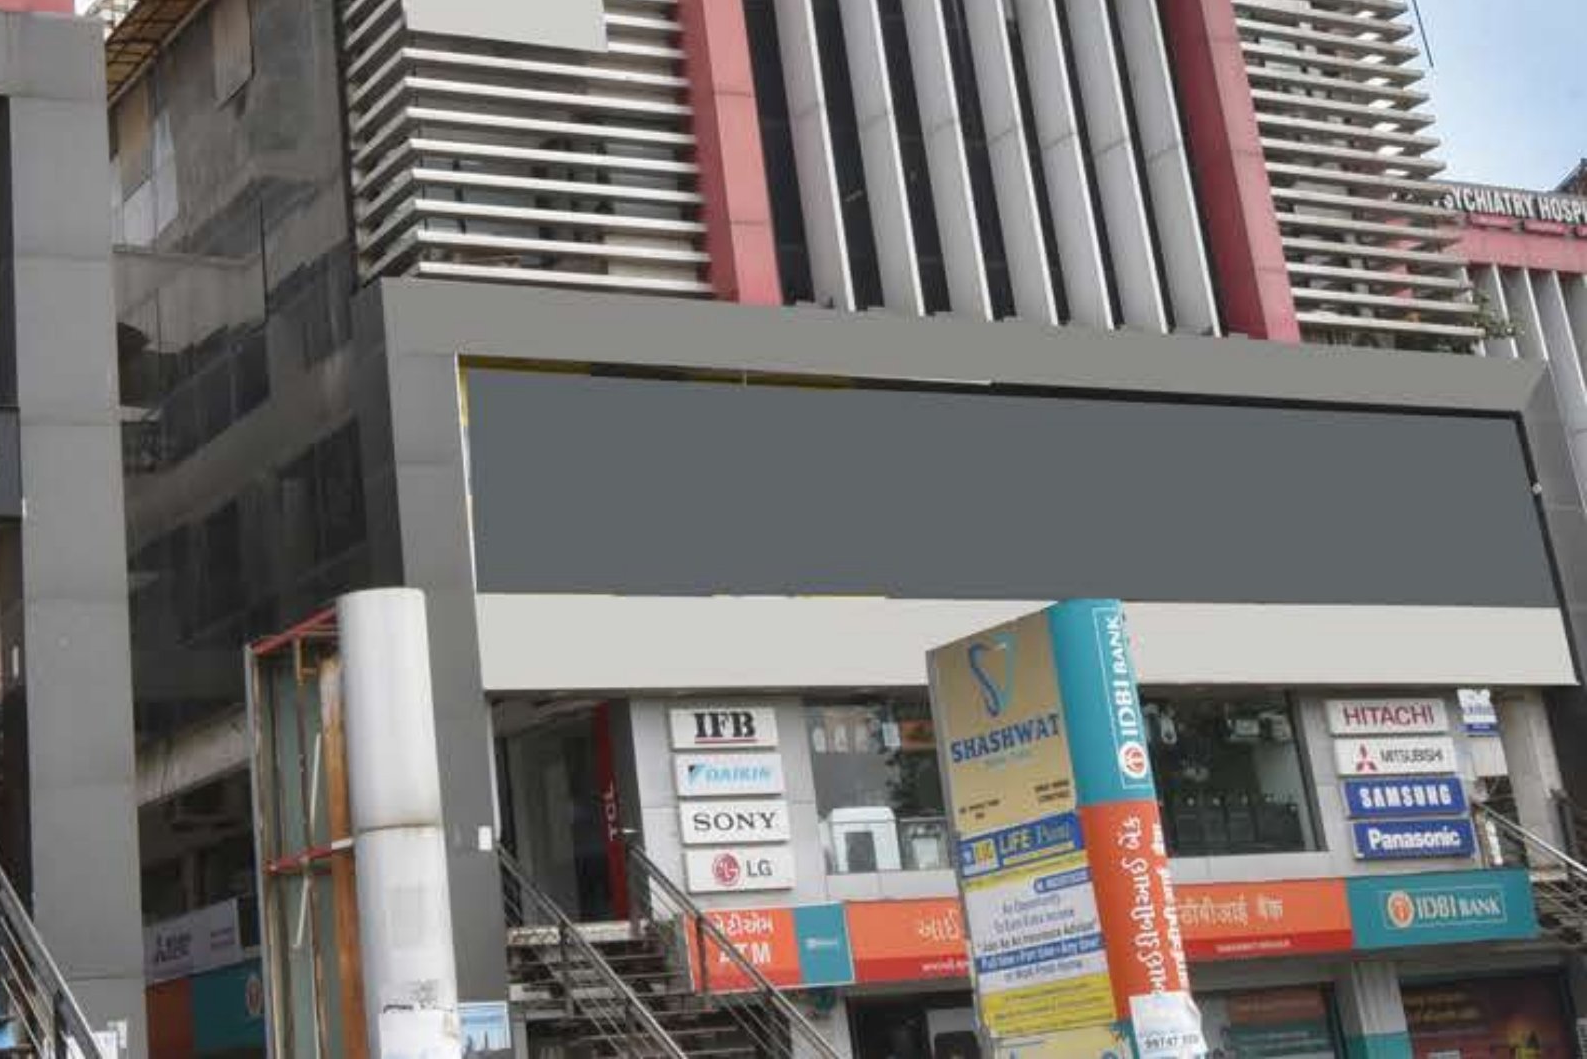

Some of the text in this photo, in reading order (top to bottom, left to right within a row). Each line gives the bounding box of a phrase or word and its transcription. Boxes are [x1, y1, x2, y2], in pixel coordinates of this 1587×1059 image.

[1432, 187, 1534, 217] YCHIATRY
[1105, 614, 1141, 737] IDBI BANK
[694, 711, 756, 738] IFB
[1343, 703, 1435, 727] HITACHI
[951, 712, 1059, 763] SHASHWAT
[1380, 748, 1444, 764] MITSUBISHI
[706, 765, 771, 782] DAIKIN
[1358, 783, 1452, 809] SAMSUNG
[693, 812, 776, 832] SONY
[1367, 827, 1461, 851] Panasonic
[745, 859, 774, 877] LG
[1418, 895, 1502, 921] IDBI BANK
